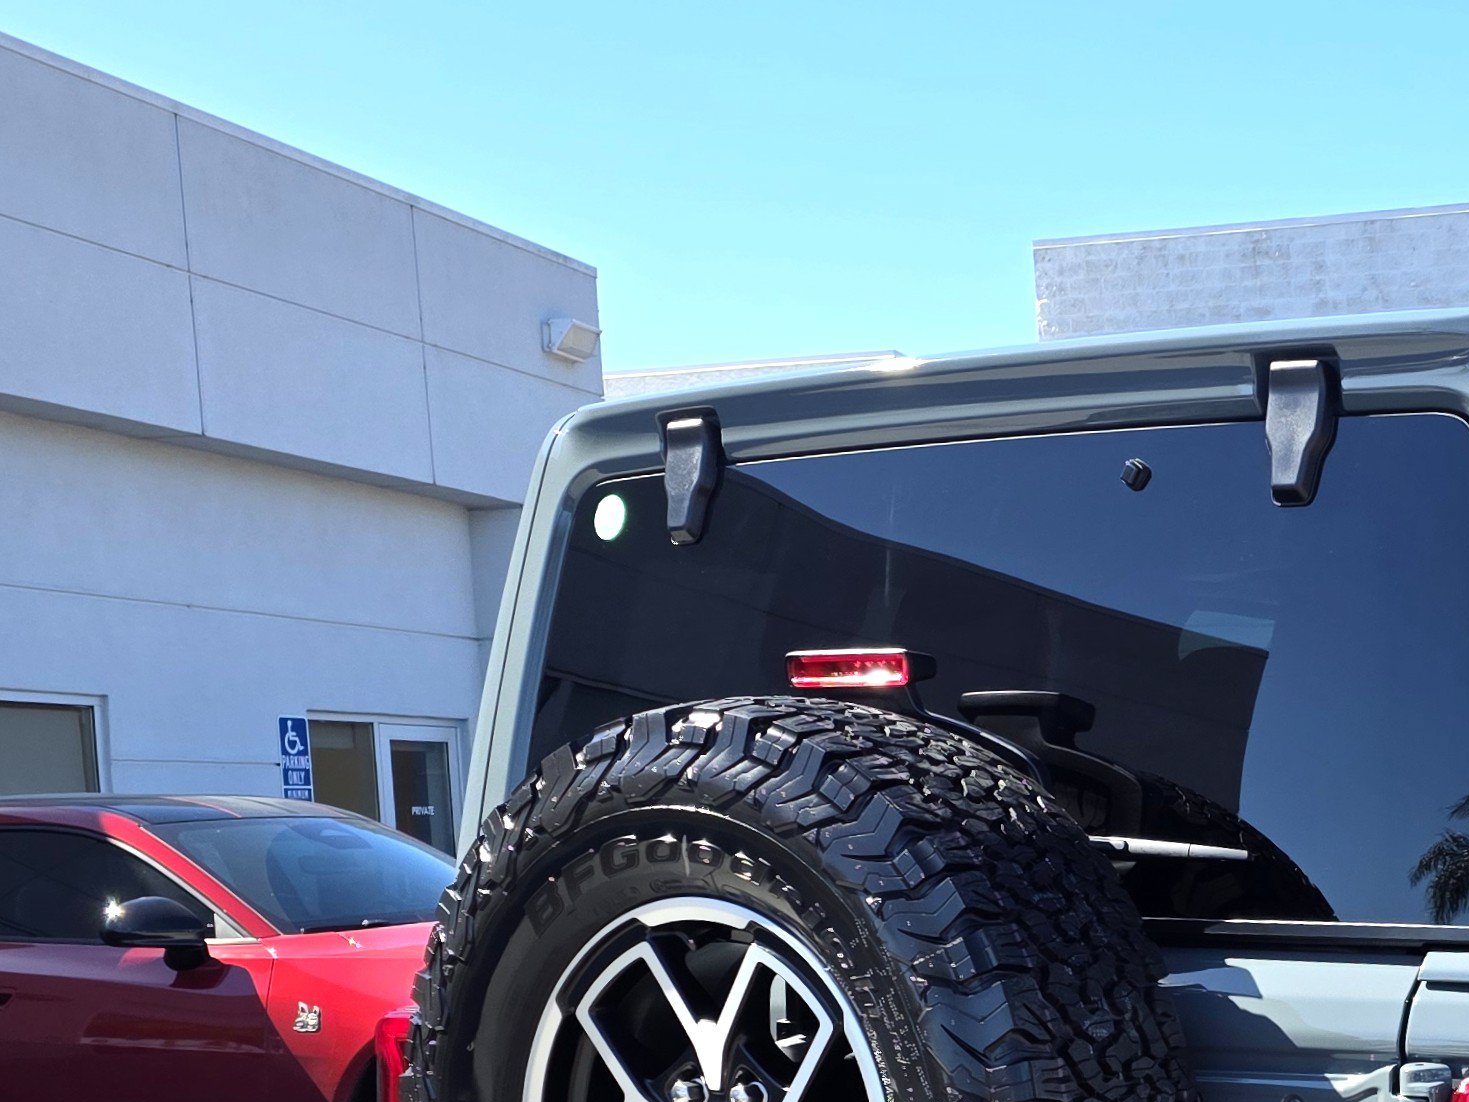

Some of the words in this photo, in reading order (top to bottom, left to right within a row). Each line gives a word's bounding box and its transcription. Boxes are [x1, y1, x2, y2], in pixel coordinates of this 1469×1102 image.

[282, 754, 310, 770] PARKING
[287, 769, 305, 785] ONLY
[411, 805, 435, 816] PRIVATE
